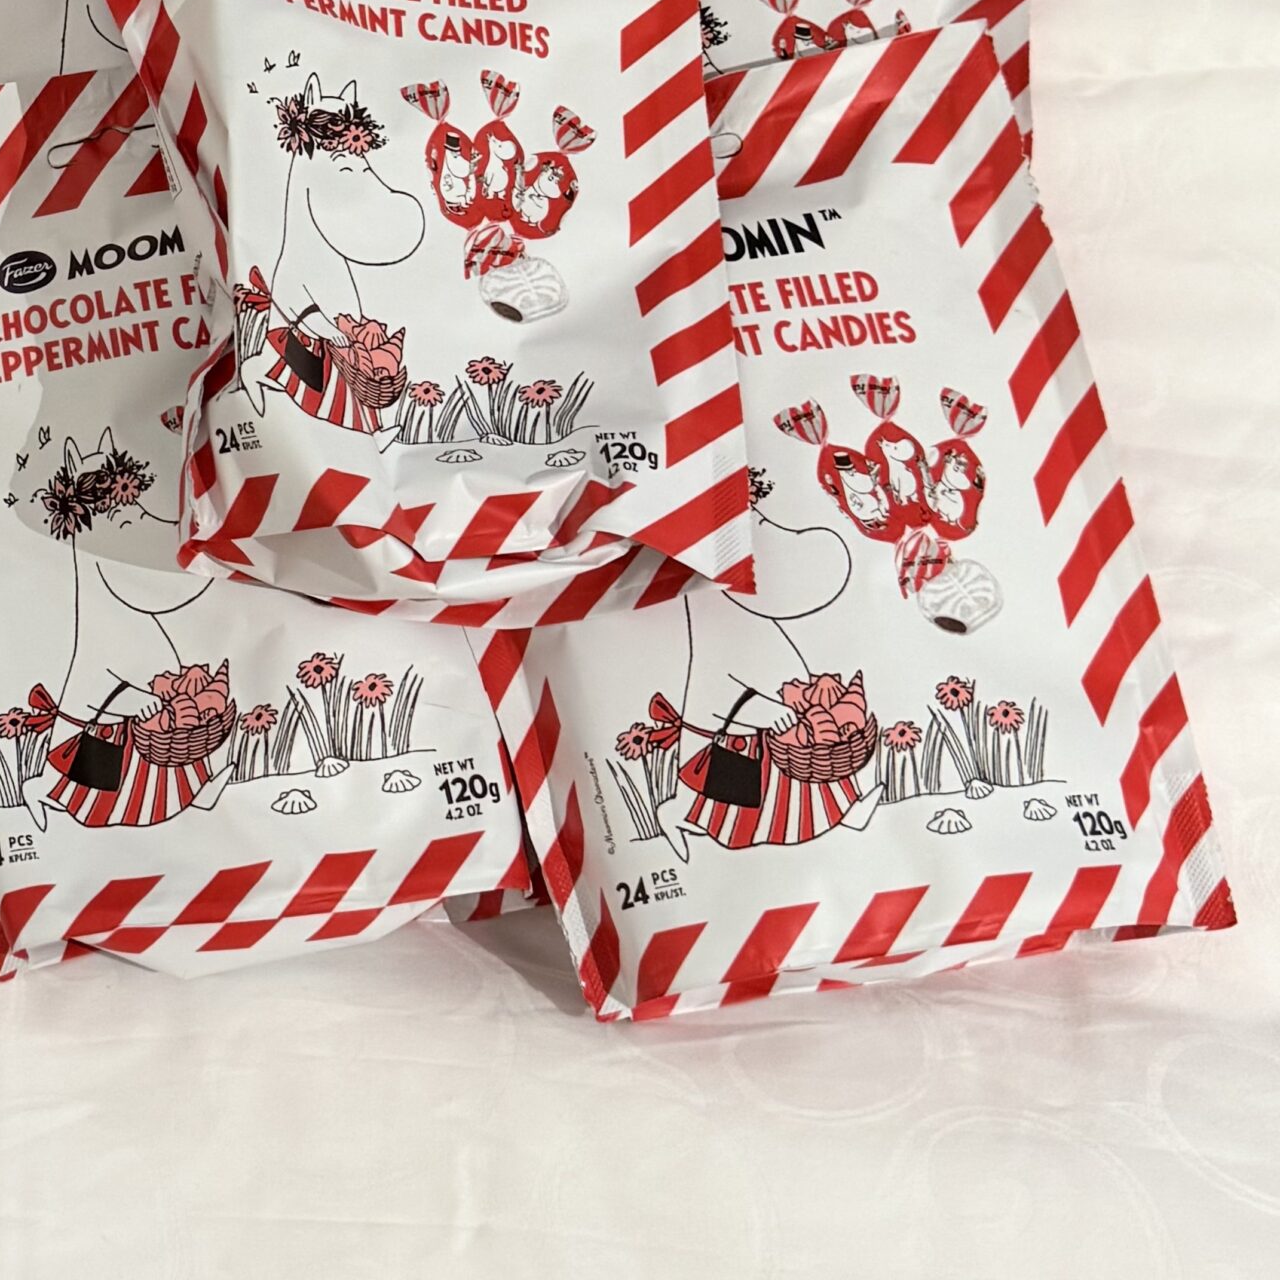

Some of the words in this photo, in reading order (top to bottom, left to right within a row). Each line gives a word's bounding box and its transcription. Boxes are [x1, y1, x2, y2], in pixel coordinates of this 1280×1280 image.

[417, 14, 550, 59] CANDIES
[3, 265, 55, 287] Fazer
[68, 226, 186, 281] MOOM
[776, 270, 879, 310] FILLED
[774, 311, 917, 353] CANDIES
[216, 426, 240, 454] 24
[237, 422, 255, 435] PCS
[595, 432, 615, 443] NET
[600, 442, 658, 470] 120g
[433, 761, 454, 776] NET
[457, 758, 474, 771] WT
[439, 774, 501, 805] 120g
[1065, 795, 1082, 808] NET
[1084, 794, 1099, 806] WT
[445, 807, 464, 821] 4.2
[466, 803, 483, 817] OZ
[1072, 811, 1128, 839] 120g
[9, 835, 34, 848] PCS
[616, 876, 650, 910] 24
[651, 868, 677, 885] PCS
